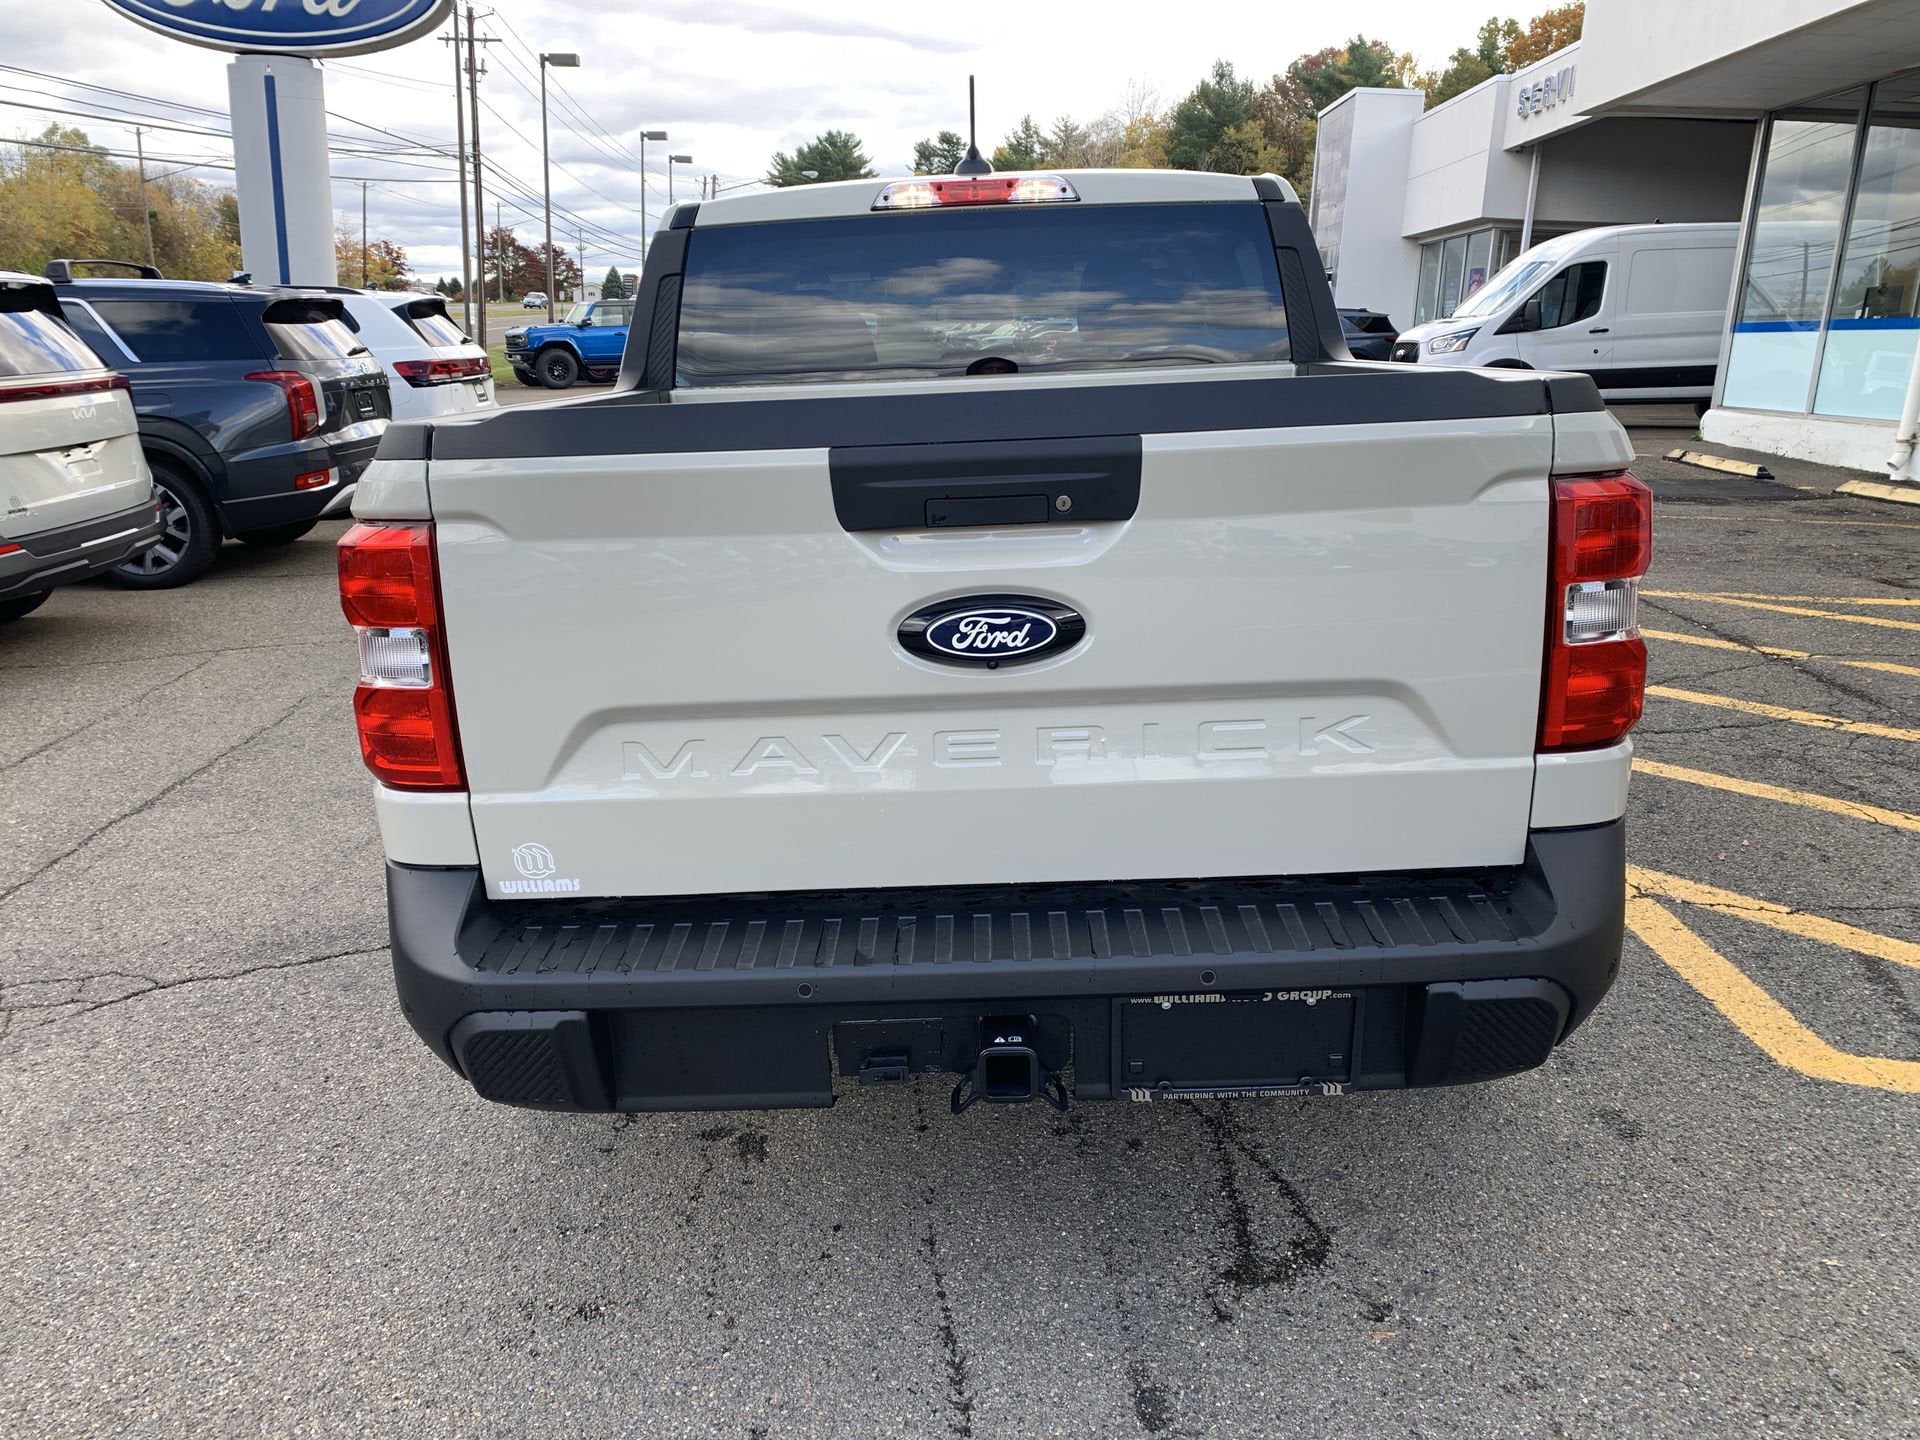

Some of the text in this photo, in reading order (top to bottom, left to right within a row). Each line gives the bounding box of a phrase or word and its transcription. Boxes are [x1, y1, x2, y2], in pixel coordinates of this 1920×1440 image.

[72, 406, 97, 420] KIA
[951, 616, 1032, 650] Ford
[620, 714, 1376, 780] MAVERICK
[499, 878, 581, 893] WILLIAMS
[1162, 1088, 1310, 1100] PARTNERING WITH THE COMMUNITY
